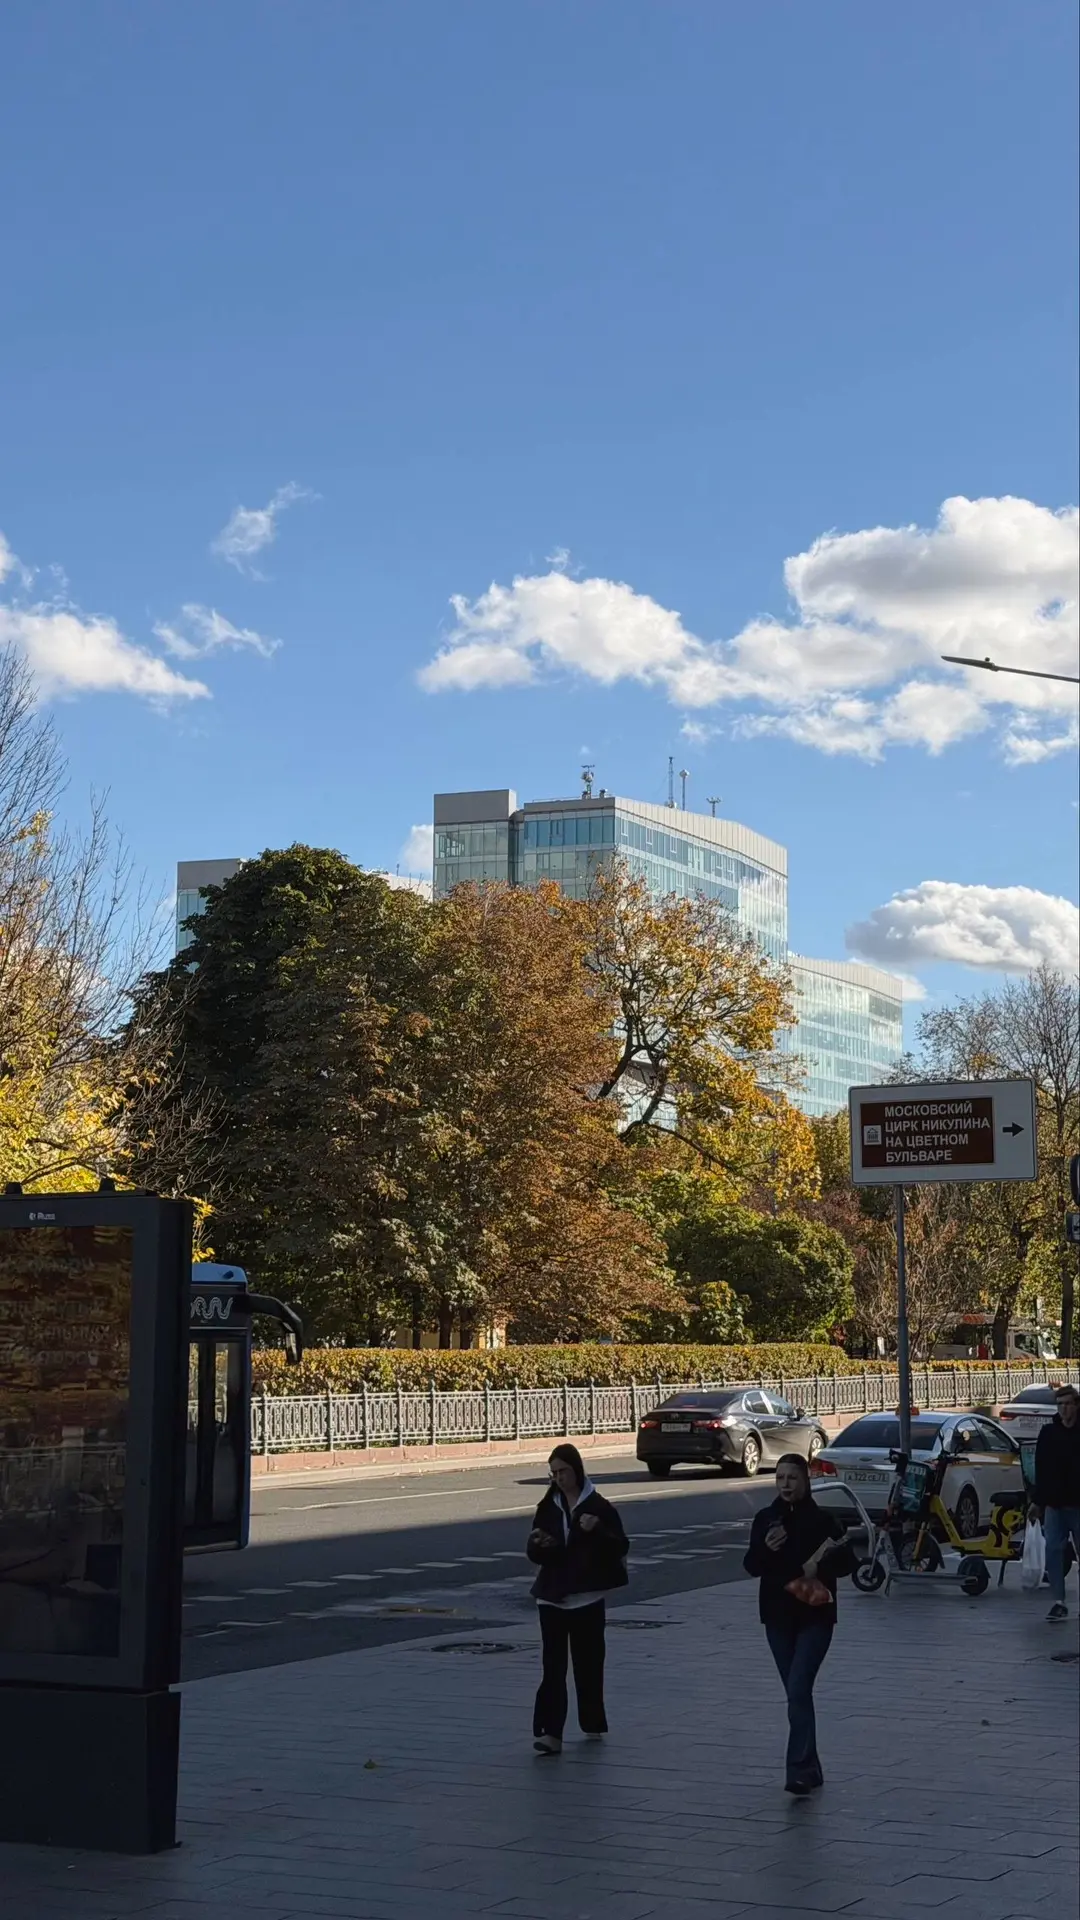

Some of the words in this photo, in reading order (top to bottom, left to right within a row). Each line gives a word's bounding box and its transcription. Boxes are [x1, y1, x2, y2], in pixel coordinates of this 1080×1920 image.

[884, 1101, 972, 1117] МОСКОВСКИЙ
[885, 1119, 918, 1134] ЦИРК
[921, 1116, 991, 1131] НИКУЛИНА
[885, 1136, 903, 1148] НА
[906, 1133, 969, 1148] ЦВЕТНОМ
[886, 1150, 953, 1163] БУЛЬВАРЕ
